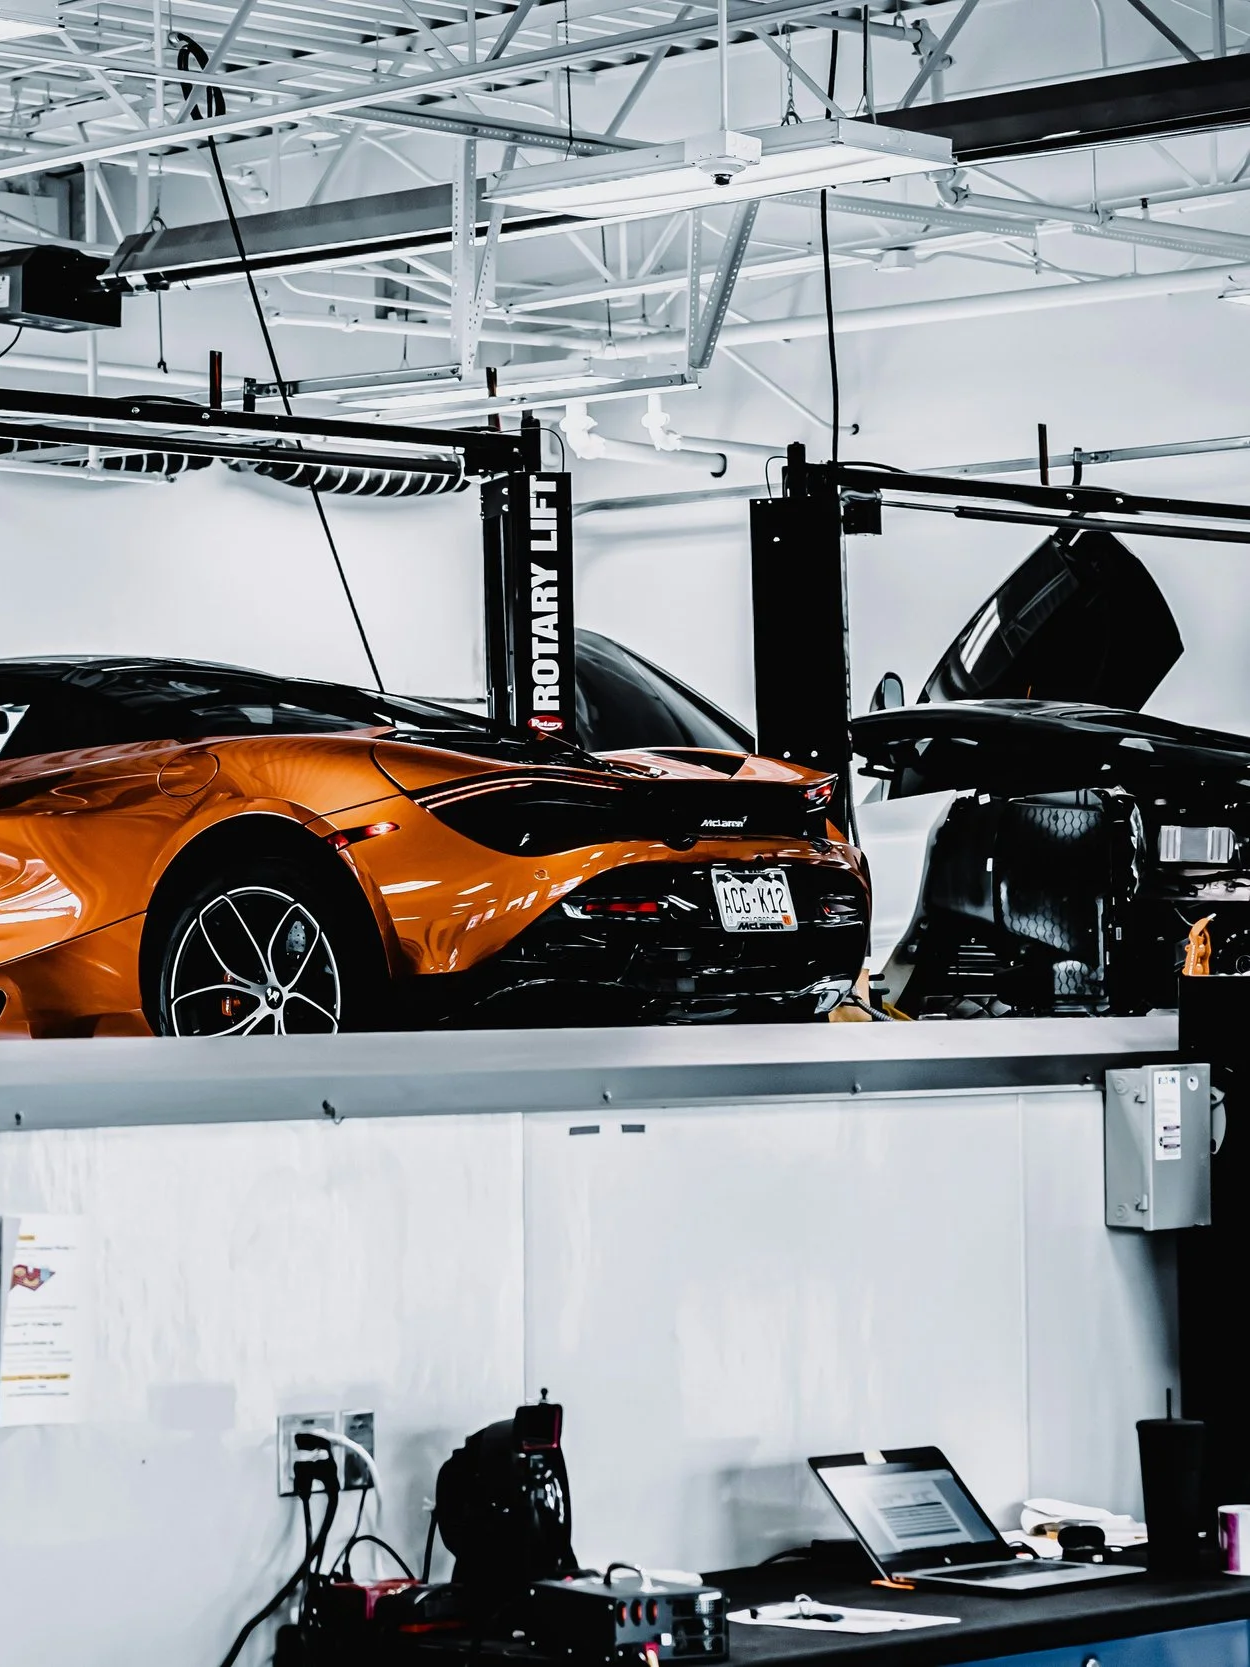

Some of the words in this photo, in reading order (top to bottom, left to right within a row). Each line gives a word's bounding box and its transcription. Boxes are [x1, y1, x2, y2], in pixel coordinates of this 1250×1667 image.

[529, 475, 558, 551] LIFT
[530, 562, 560, 711] ROTARY
[530, 718, 563, 731] Rotary
[700, 818, 744, 828] McLaren
[737, 922, 784, 931] McLaren
